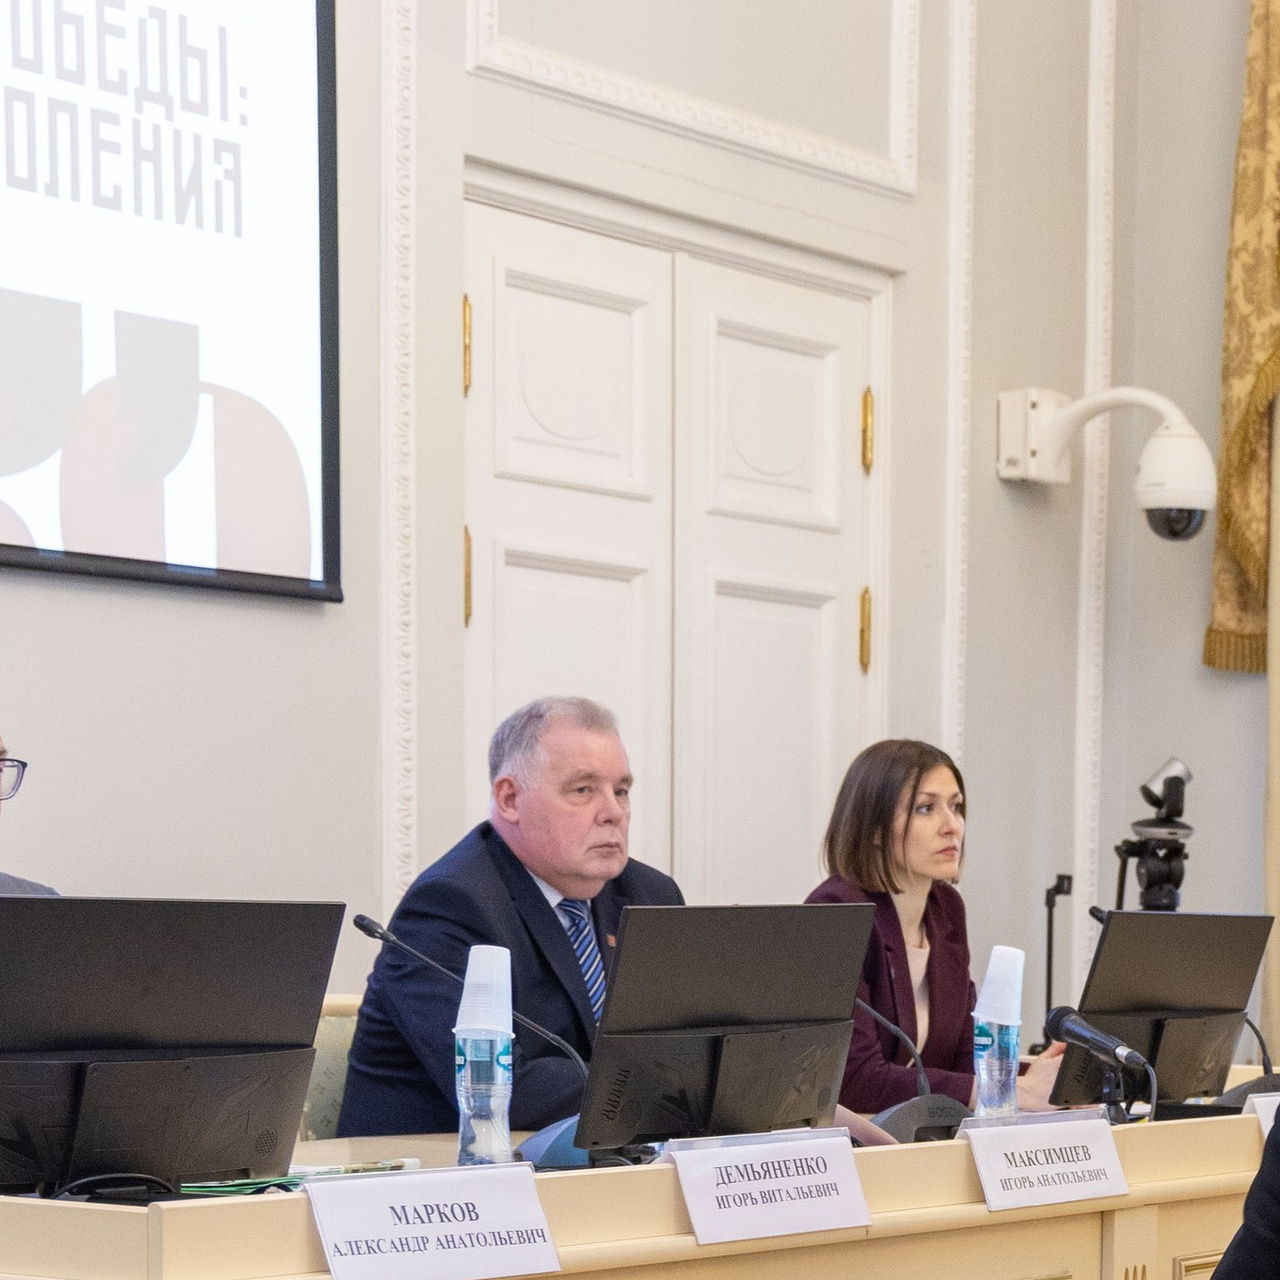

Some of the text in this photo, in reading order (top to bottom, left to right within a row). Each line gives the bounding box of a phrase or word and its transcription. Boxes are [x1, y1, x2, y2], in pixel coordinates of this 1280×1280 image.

[3, 84, 243, 239] ОЛЕНИЯ
[1003, 1144, 1092, 1169] МАКСИМЦЕВ
[714, 1155, 828, 1188] ДЕМЬЯНЕНКО
[999, 1168, 1109, 1192] ИГОРЬ АНАТОЛЬЕВИЧ
[715, 1182, 840, 1210] ИГОРЬ ВИТАЛЬЕВИЧ
[389, 1202, 480, 1226] МАРКОВ
[332, 1228, 549, 1258] АЛЕКСАНДР АНАТОЛЬЕВИЧ
